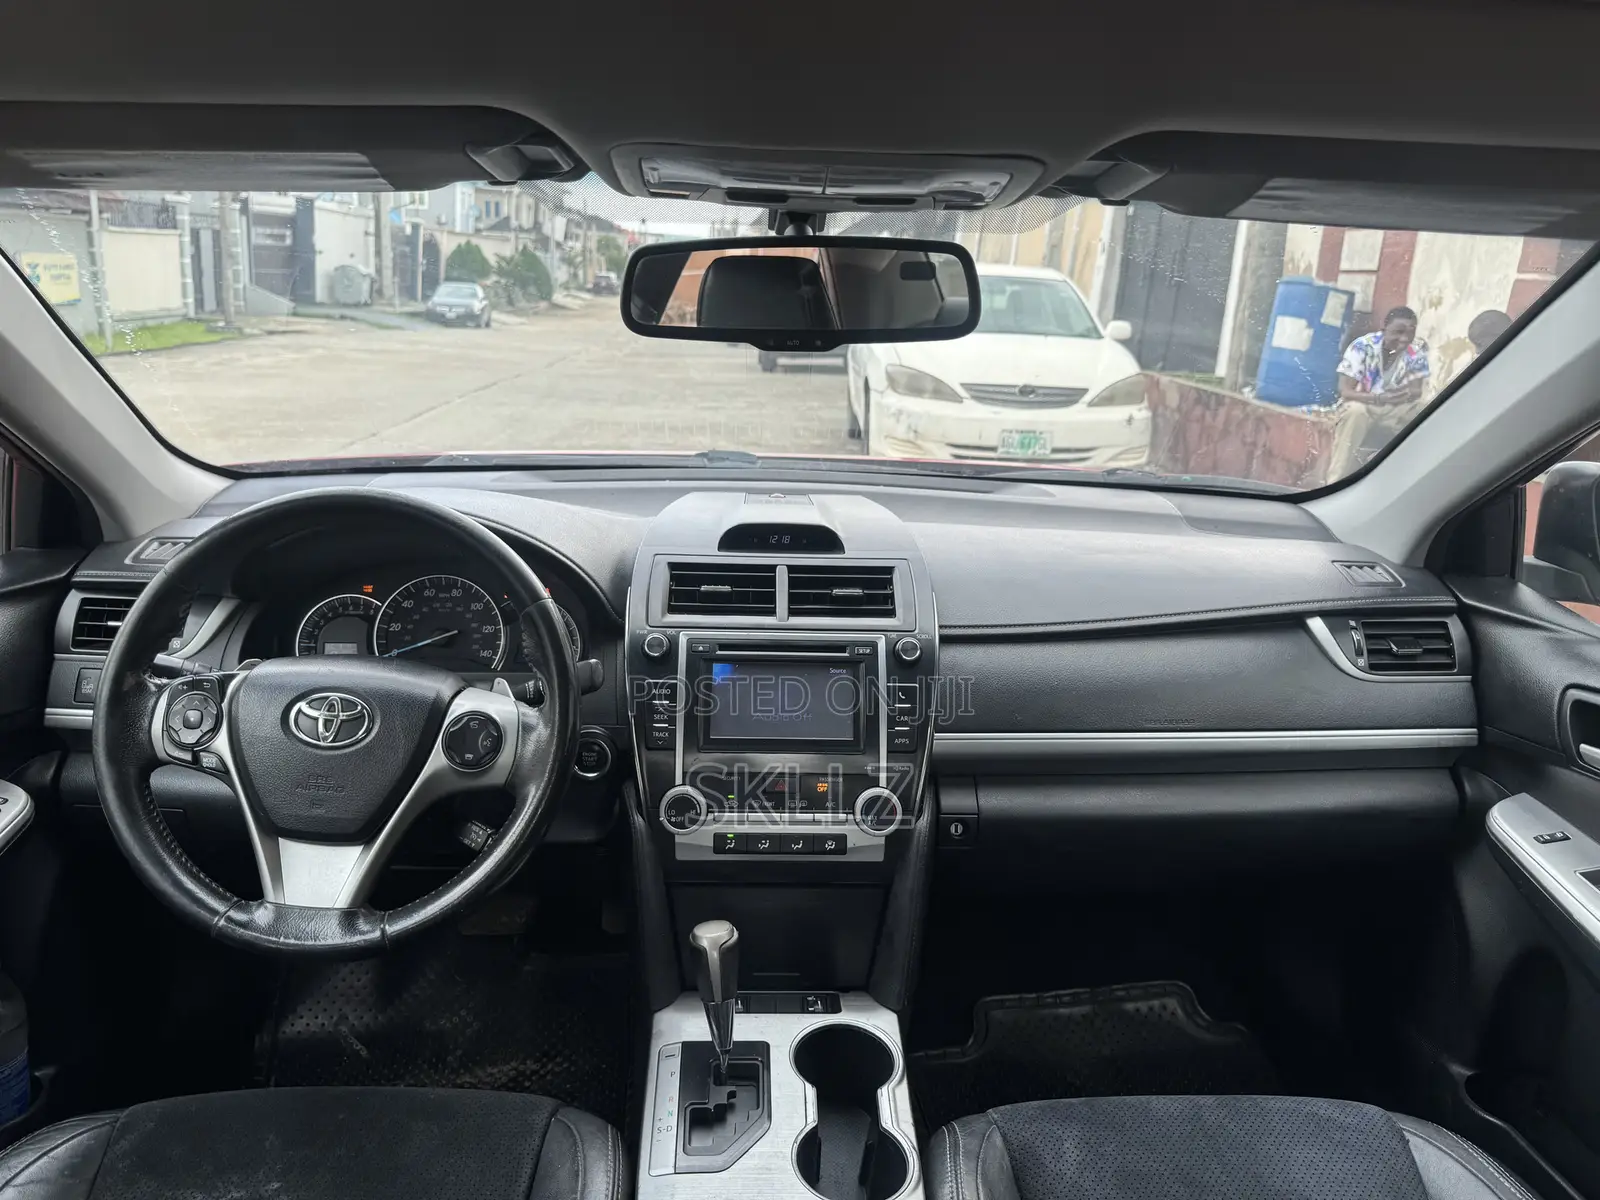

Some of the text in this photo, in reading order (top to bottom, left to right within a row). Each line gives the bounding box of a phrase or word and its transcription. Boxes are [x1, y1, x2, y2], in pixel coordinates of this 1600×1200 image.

[424, 588, 436, 597] 60
[450, 588, 462, 597] 80
[401, 600, 414, 608] 40
[470, 602, 484, 610] 100
[388, 623, 401, 631] 20
[482, 625, 495, 633] 120
[480, 650, 493, 658] 140
[670, 1070, 676, 1078] P
[667, 1109, 673, 1117] N
